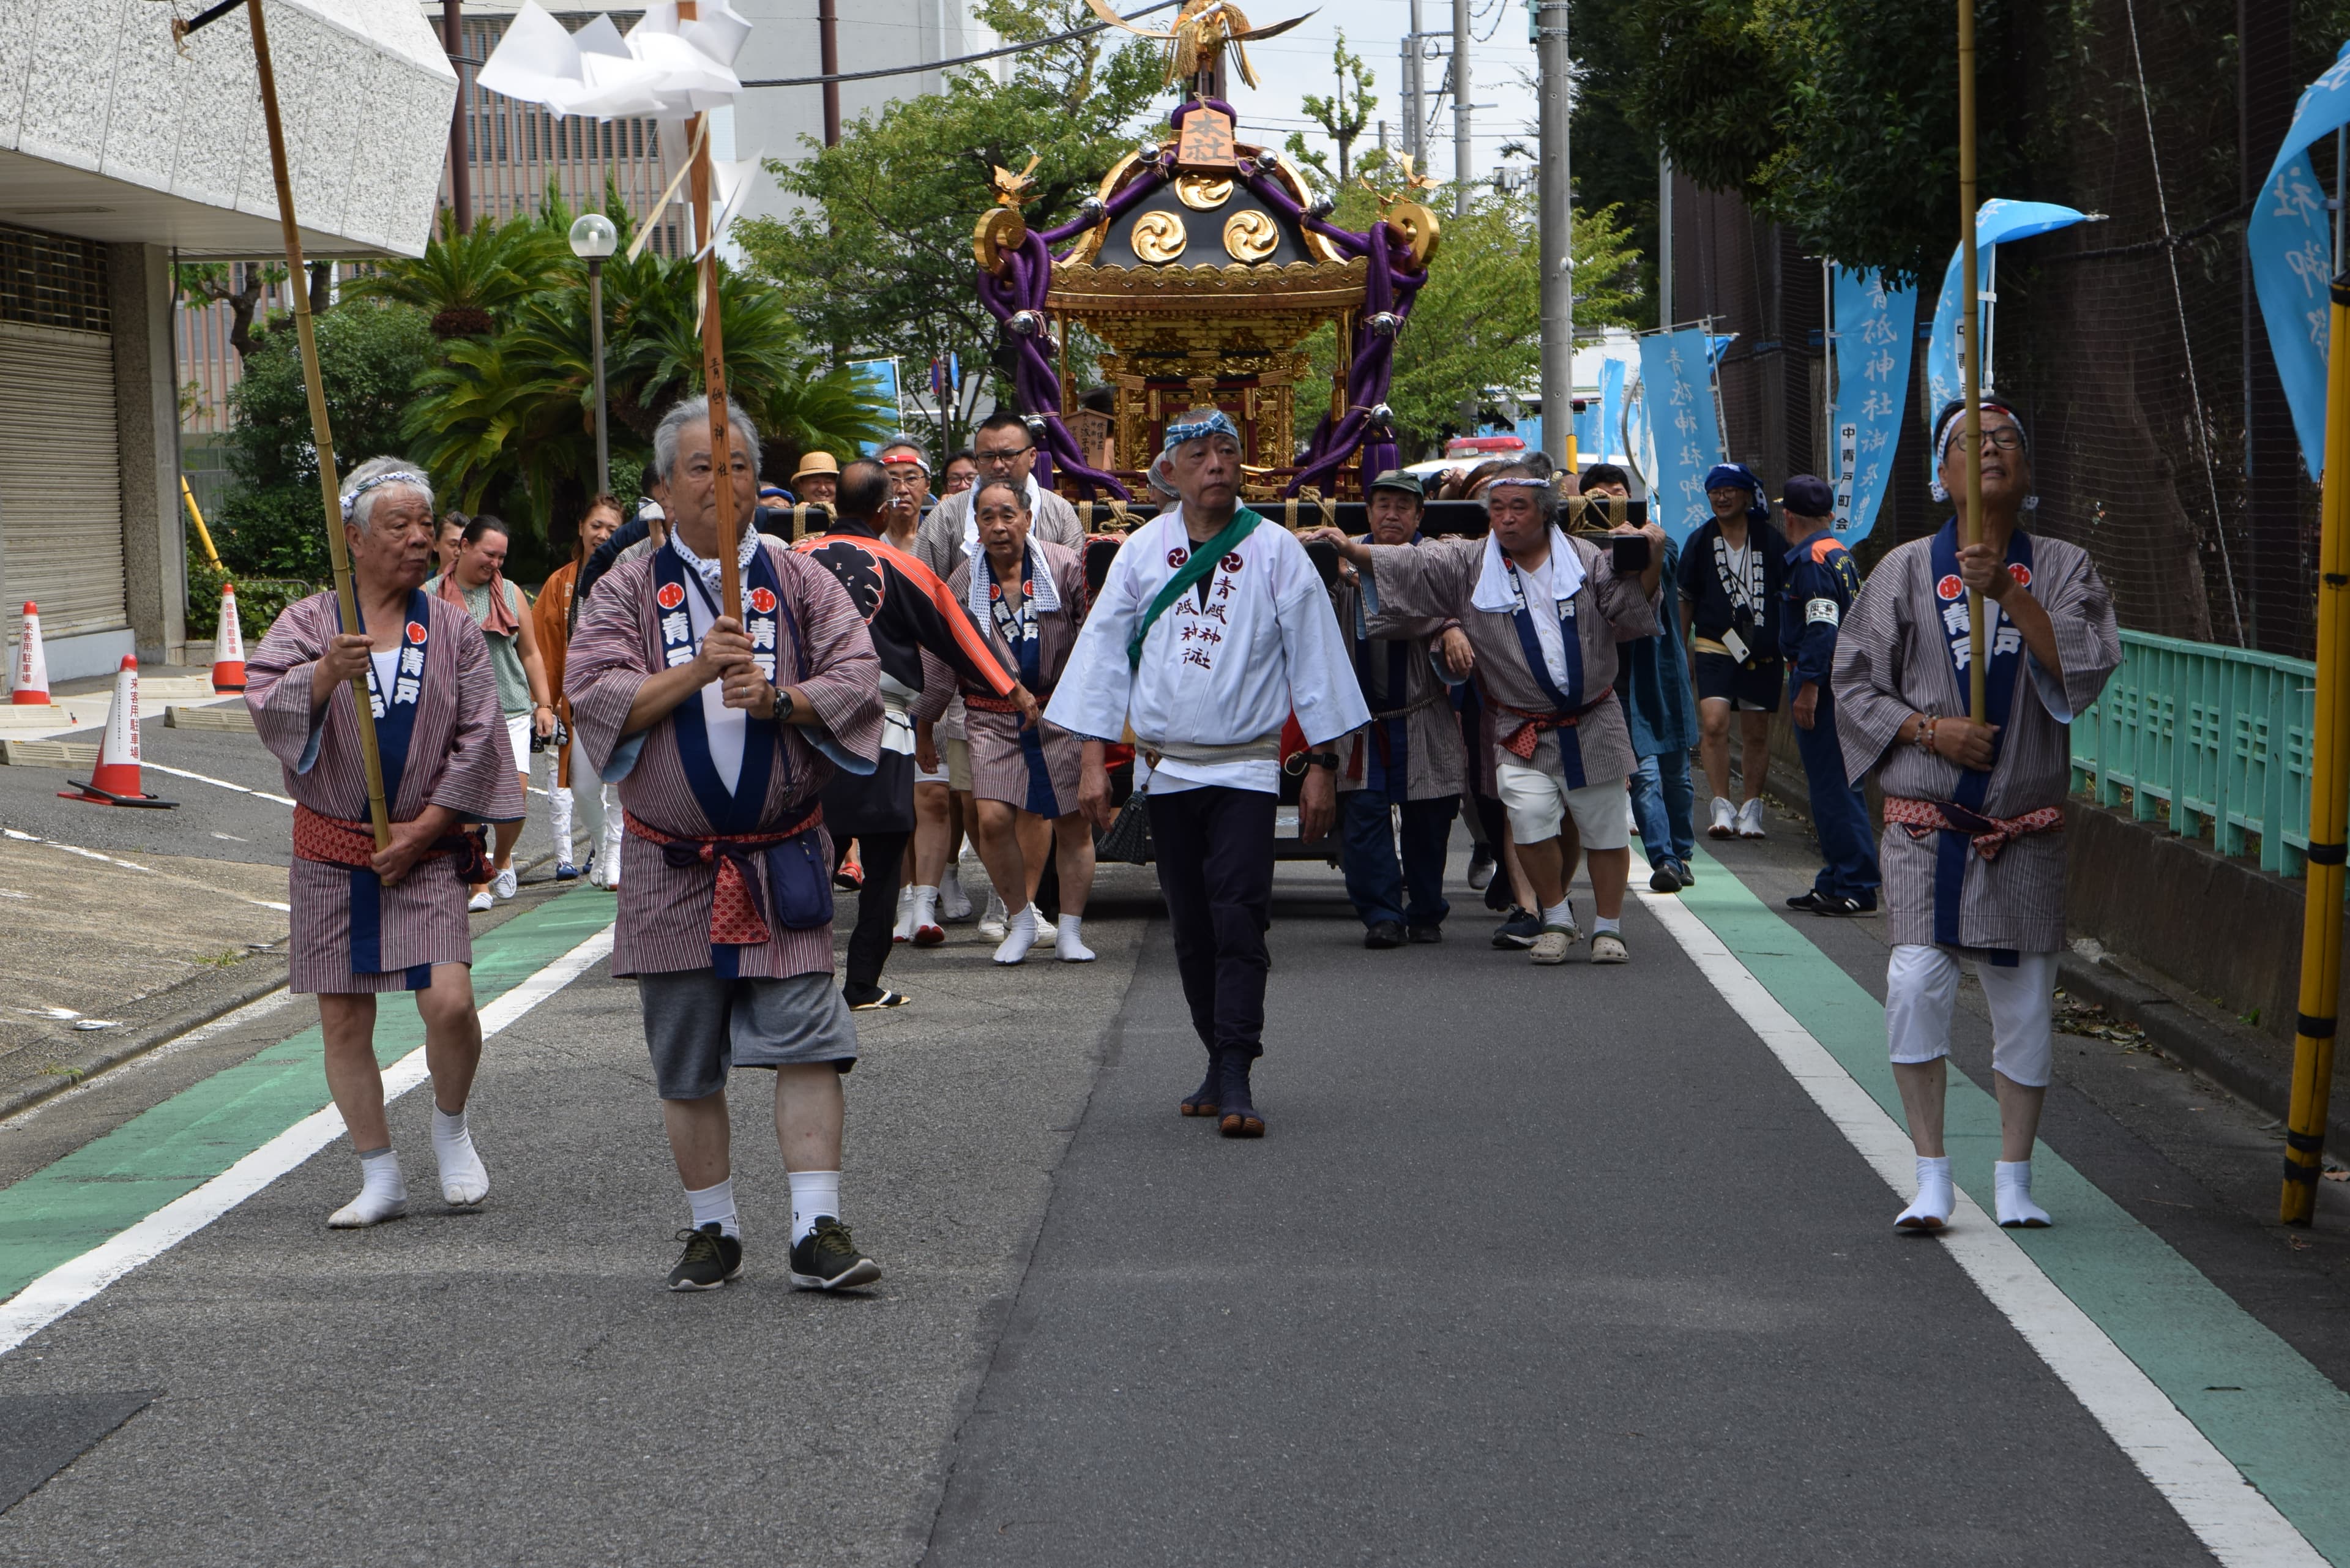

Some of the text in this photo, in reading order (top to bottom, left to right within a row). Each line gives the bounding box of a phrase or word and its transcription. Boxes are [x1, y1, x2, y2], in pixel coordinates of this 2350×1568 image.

[1185, 113, 1230, 162] 本社
[1836, 427, 1855, 530] 中青戸町会
[22, 622, 33, 684] 来客用駐車場
[993, 601, 1020, 643] 青戸
[1190, 576, 1236, 670] 青砥神社
[395, 648, 424, 704] 青戸
[130, 678, 139, 759] 来客用駐車場
